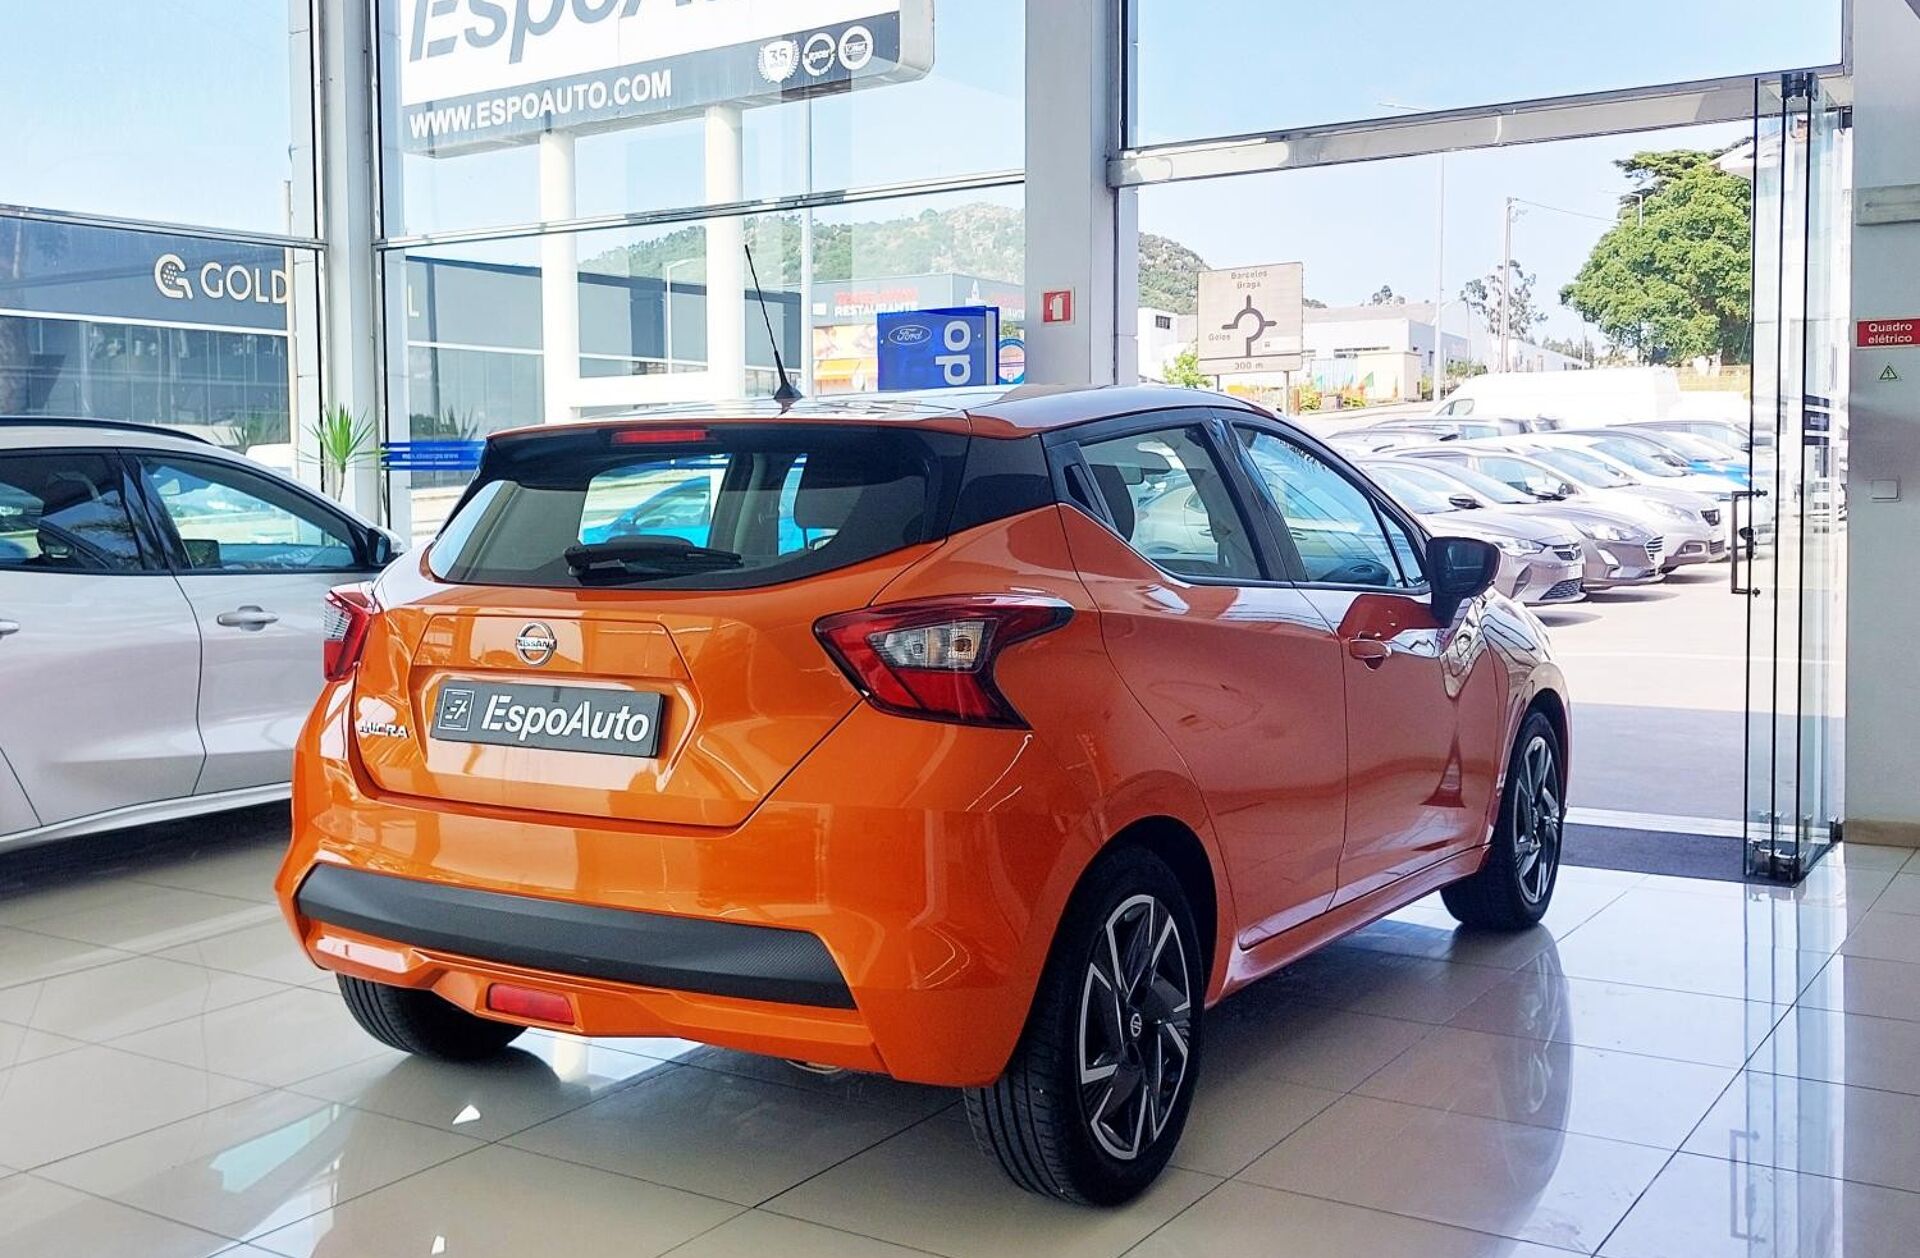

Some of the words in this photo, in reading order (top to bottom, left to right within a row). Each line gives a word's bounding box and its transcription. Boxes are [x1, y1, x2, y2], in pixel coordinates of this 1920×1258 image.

[409, 69, 672, 139] WWW.ESPOAUTO.COM
[200, 262, 287, 304] GOLD
[1868, 322, 1913, 333] Quadro
[896, 328, 924, 342] Ford
[1868, 333, 1913, 344] elétrico
[516, 638, 550, 649] NISSAN
[480, 694, 651, 743] EspoAuto
